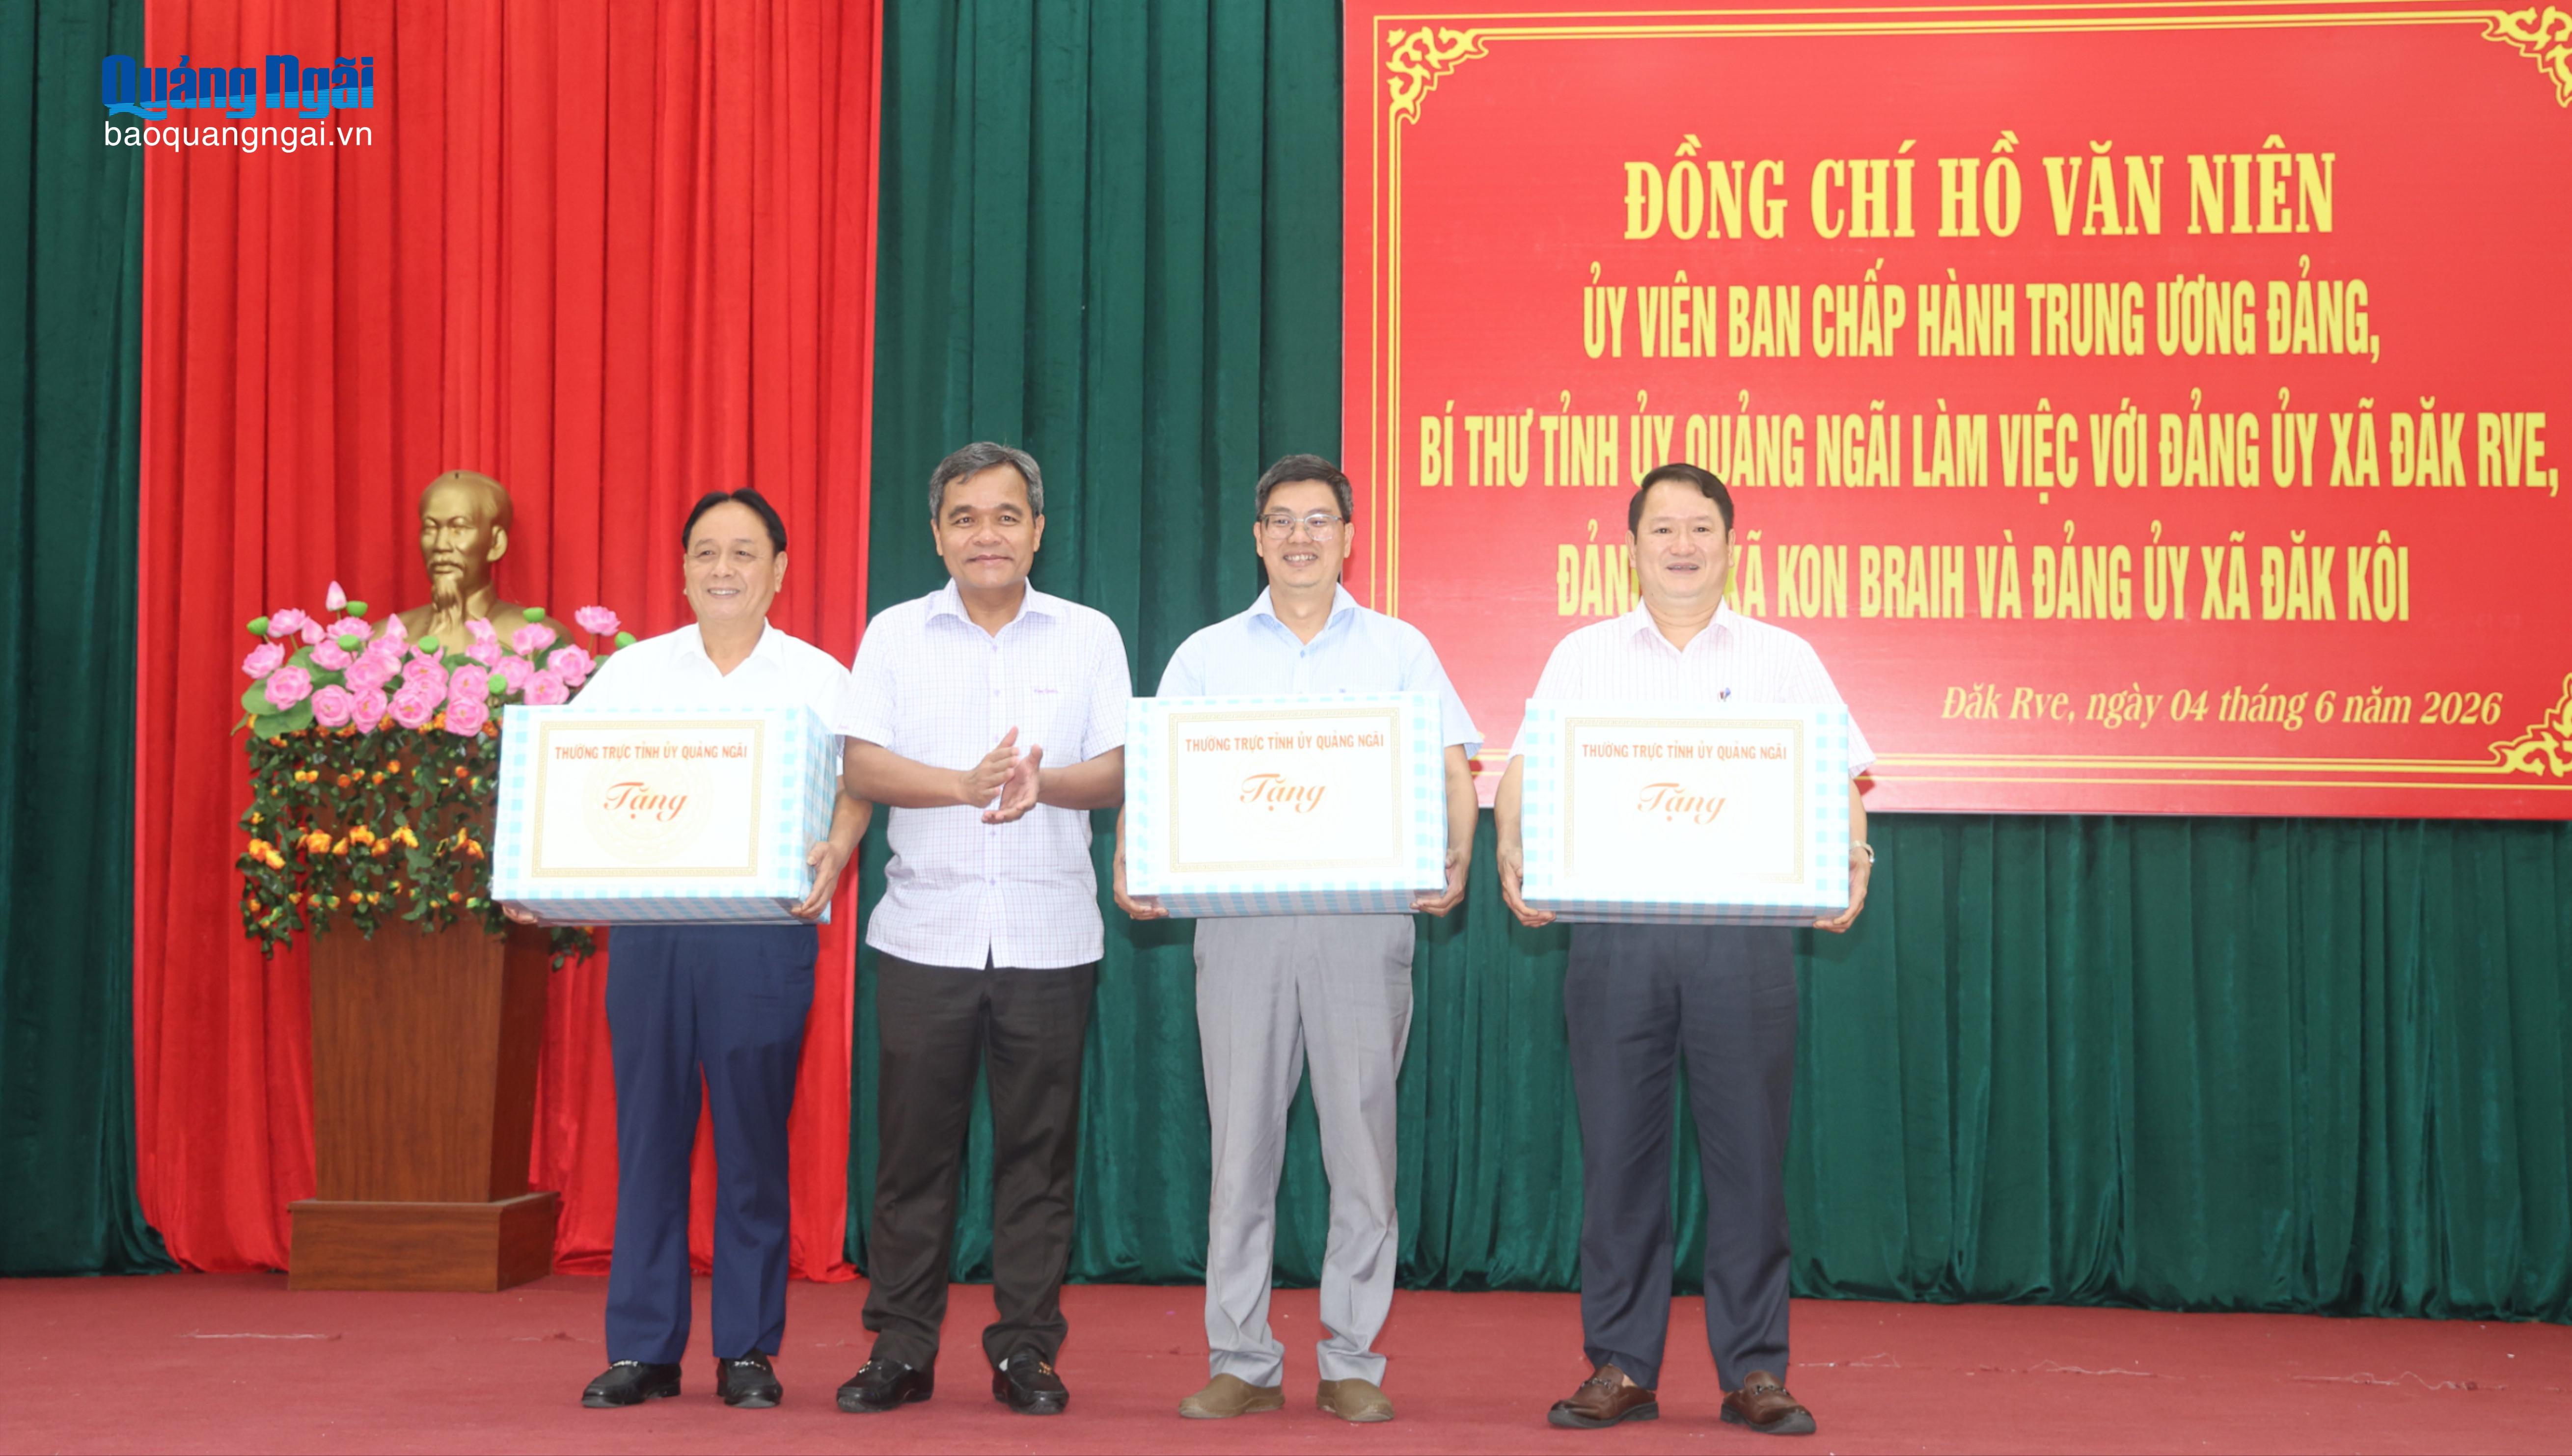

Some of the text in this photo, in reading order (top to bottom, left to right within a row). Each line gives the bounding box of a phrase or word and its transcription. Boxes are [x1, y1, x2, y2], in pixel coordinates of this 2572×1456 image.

[1624, 130, 2336, 240] ĐỒNG CHÍ HỒ VĂN NIÊN
[1584, 254, 2380, 363] ỦY VIÊN BAN CHẤP HÀNH TRUNG ƯƠNG ĐẢNG,
[1420, 386, 2559, 505] BÍ THƯ TỈNH ỦY QUẢNG NGÃI LÀM VIỆC VỚI ĐẢNG ỦY XÃ ĐĂK RVE,
[1557, 519, 1641, 616] ĐẢN
[1777, 544, 1848, 619] KON
[1860, 545, 1965, 619] BRAIH
[1975, 529, 2023, 619] VÀ
[2032, 520, 2132, 621] ĐẢNG
[2144, 520, 2190, 621] ỦY
[2201, 531, 2251, 620] XÃ
[2261, 530, 2336, 620] ĐĂK
[2348, 530, 2409, 622] KÔI
[1941, 681, 2503, 731] Đăk Rve, ngày 04 tháng 6 năm 2026
[555, 741, 747, 761] THƯỜNG TRỰC TỈNH ỦY QUẢNG NGÃI
[1185, 730, 1384, 753] THƯỜNG TRỰC TỈNH ỦY QUẢNG NGÃI
[1582, 740, 1787, 761] THƯỜNG TRỰC TỈNH ỦY QUẢNG NGÃI
[602, 781, 689, 822] Tặng
[1239, 773, 1326, 813] Tặng
[1637, 782, 1726, 825] Tặng
